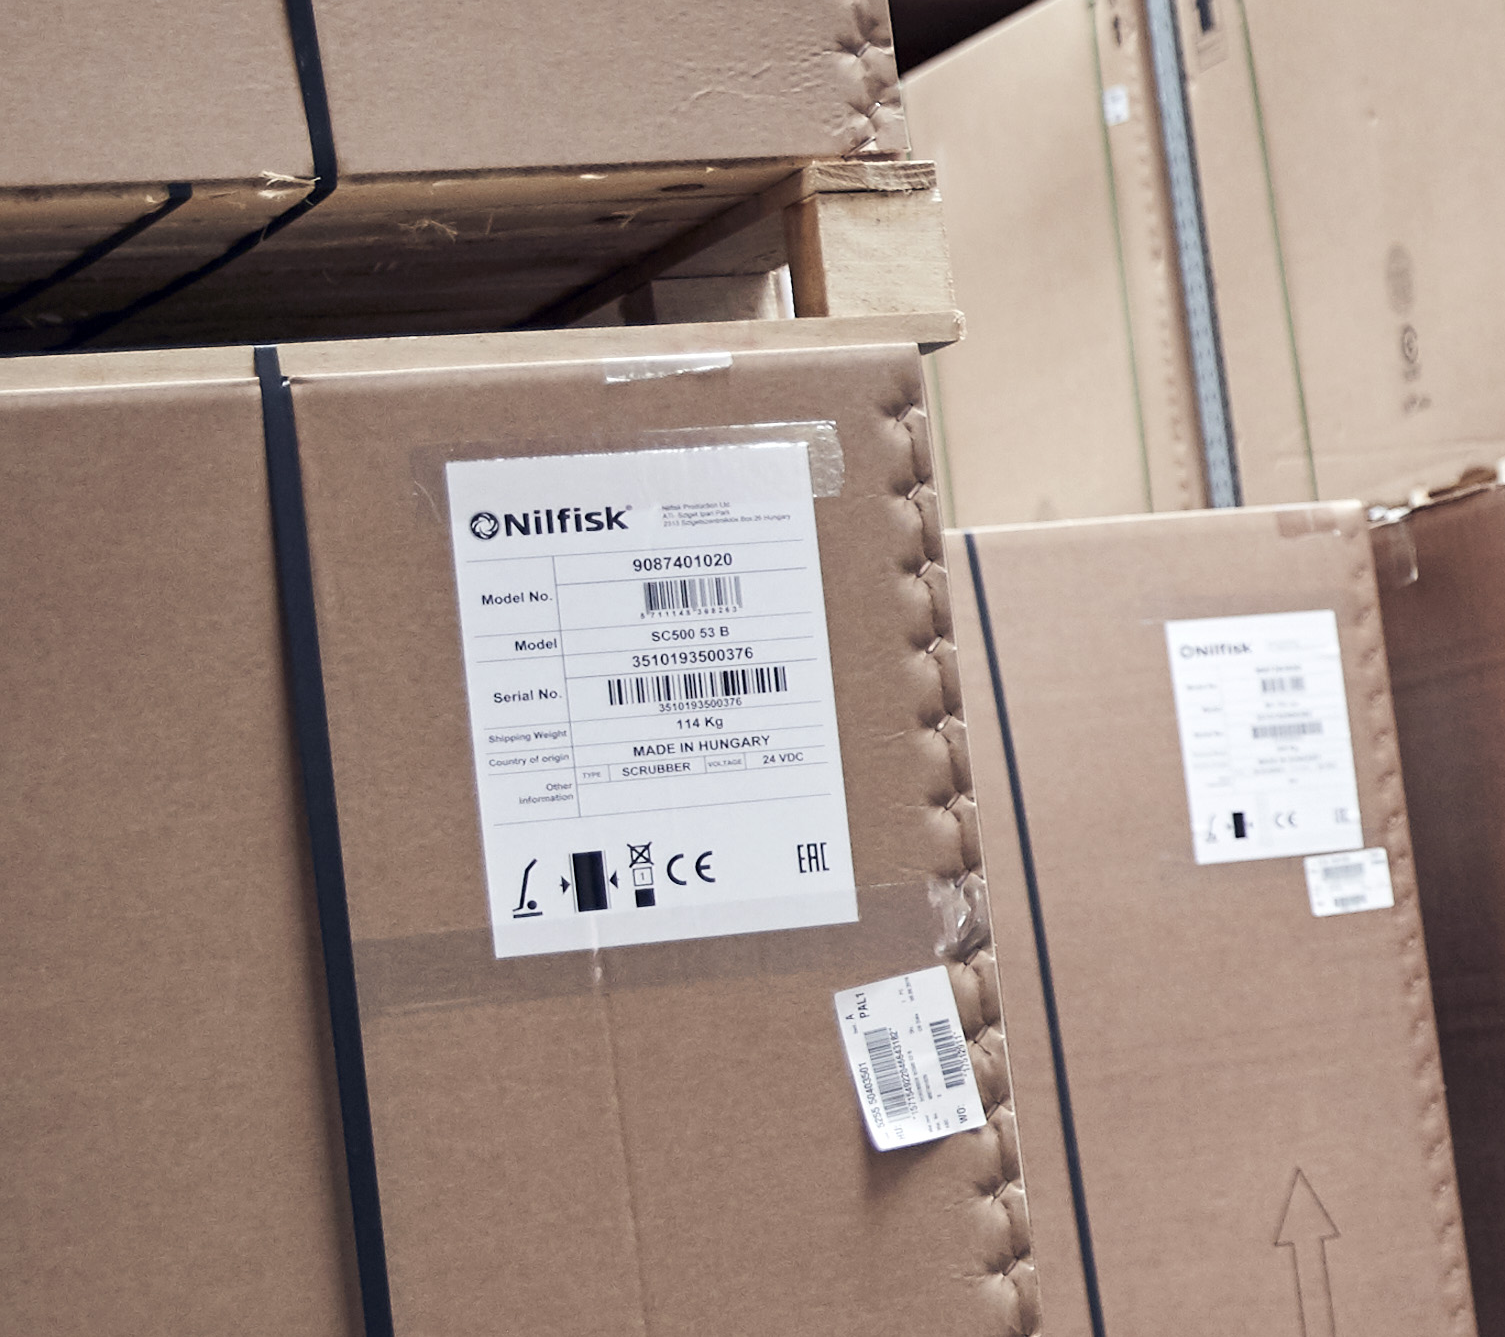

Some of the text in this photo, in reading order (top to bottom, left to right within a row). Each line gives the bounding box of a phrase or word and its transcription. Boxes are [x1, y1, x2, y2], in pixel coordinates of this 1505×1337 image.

[504, 506, 629, 537] Nilfisk
[632, 552, 733, 573] 9087401020
[481, 590, 554, 606] Model No.
[651, 626, 730, 642] SC500 53 B
[514, 638, 558, 652] Model
[1195, 643, 1253, 657] Nilfisk
[631, 646, 754, 668] 3510193500376
[493, 687, 563, 704] Serial No.
[658, 697, 743, 712] 3510193500376
[676, 716, 724, 730] 114 Kg
[488, 728, 568, 745] Shipping Weight
[632, 735, 771, 758] MADE IN HUNGARY
[488, 753, 570, 768] Country of origin
[762, 751, 805, 765] 24 VDC
[621, 760, 692, 778] SCRUBBER
[546, 781, 573, 792] Other
[666, 850, 717, 887] CE
